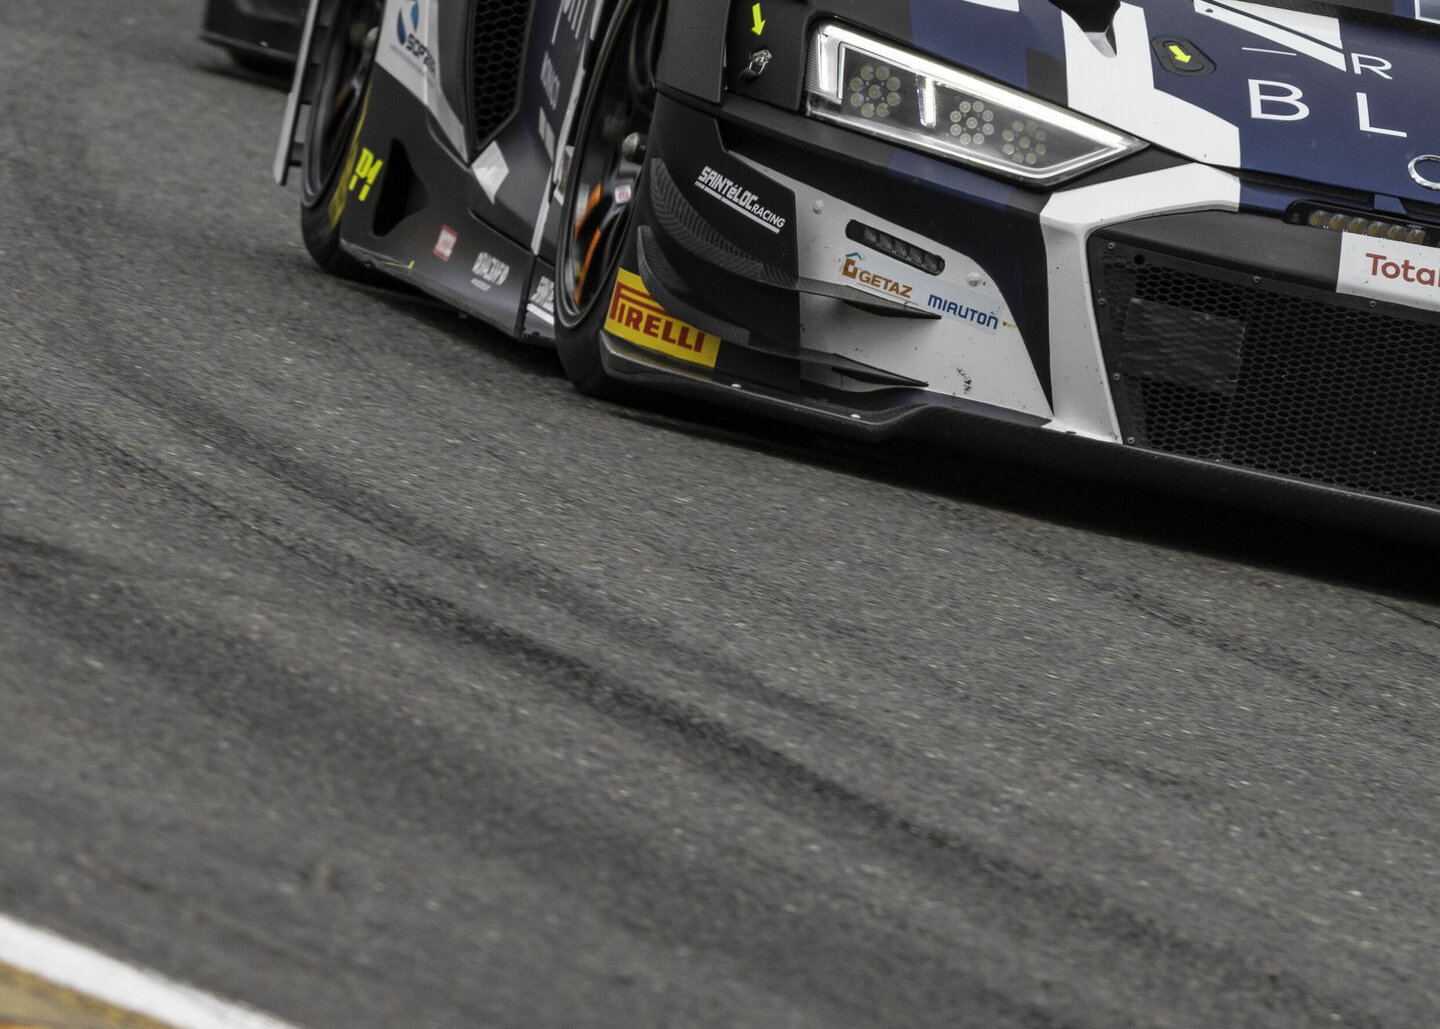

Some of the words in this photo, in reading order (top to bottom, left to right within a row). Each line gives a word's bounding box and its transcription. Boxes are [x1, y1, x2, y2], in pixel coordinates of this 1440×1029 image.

[609, 281, 706, 353] PIRELLI
[858, 269, 914, 299] GETAZ
[927, 294, 999, 330] MIAUTON
